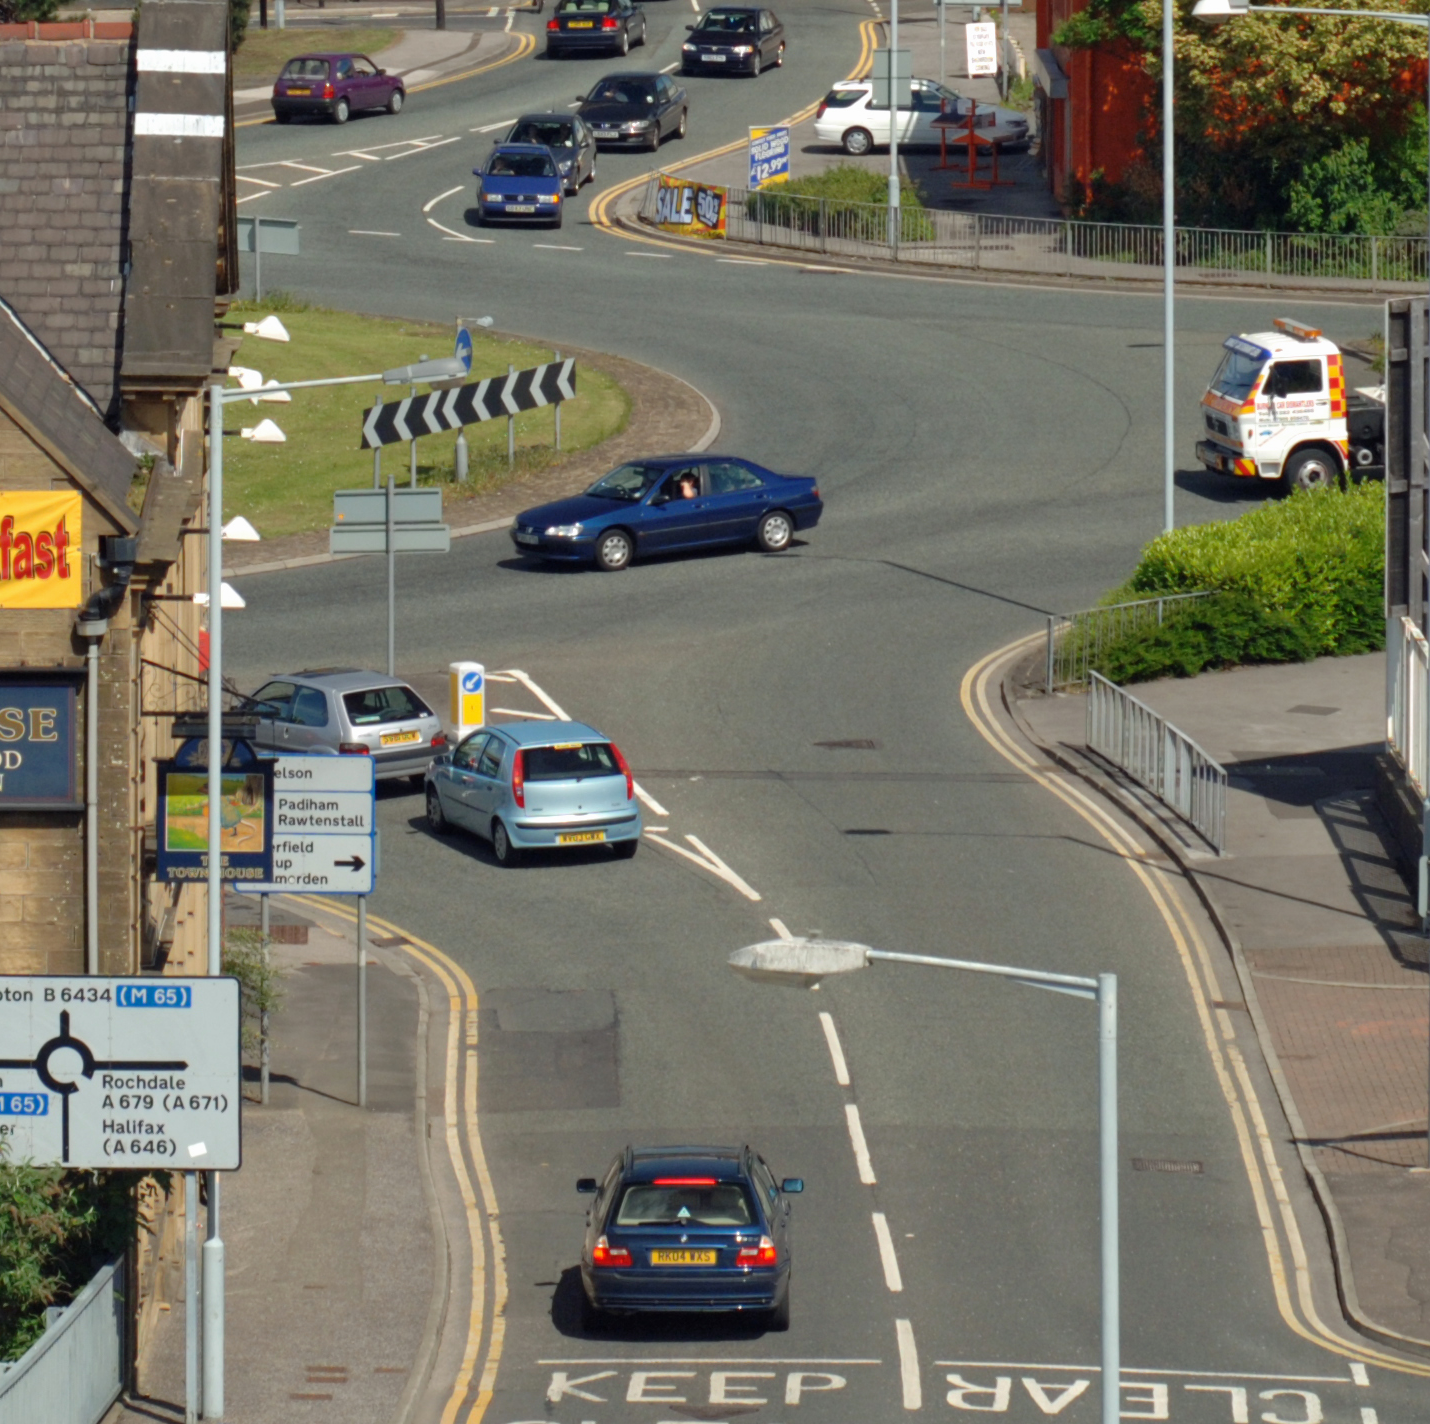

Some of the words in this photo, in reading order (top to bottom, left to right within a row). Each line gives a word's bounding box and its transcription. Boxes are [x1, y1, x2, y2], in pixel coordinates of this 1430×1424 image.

[656, 187, 693, 224] SALE
[273, 766, 313, 779] elson
[278, 798, 339, 812] Padiham
[278, 813, 365, 828] Rawtenstall
[200, 855, 230, 867] TE
[273, 873, 329, 885] morden
[44, 988, 56, 1002] B
[61, 987, 112, 1003] 6434
[120, 987, 150, 1006] (M
[154, 987, 189, 1007] 65)
[103, 1075, 186, 1090] Rochdale
[10, 1095, 45, 1115] 65)
[102, 1095, 115, 1110] A
[120, 1094, 154, 1110] 679
[162, 1094, 186, 1112] (A
[189, 1094, 229, 1112] 671)
[103, 1119, 165, 1136] Halifax
[103, 1138, 125, 1156] (A
[130, 1138, 177, 1157] 646)
[657, 1251, 686, 1262] RK04
[546, 1370, 848, 1405] KEEP
[946, 1373, 1324, 1424] CLEAR
